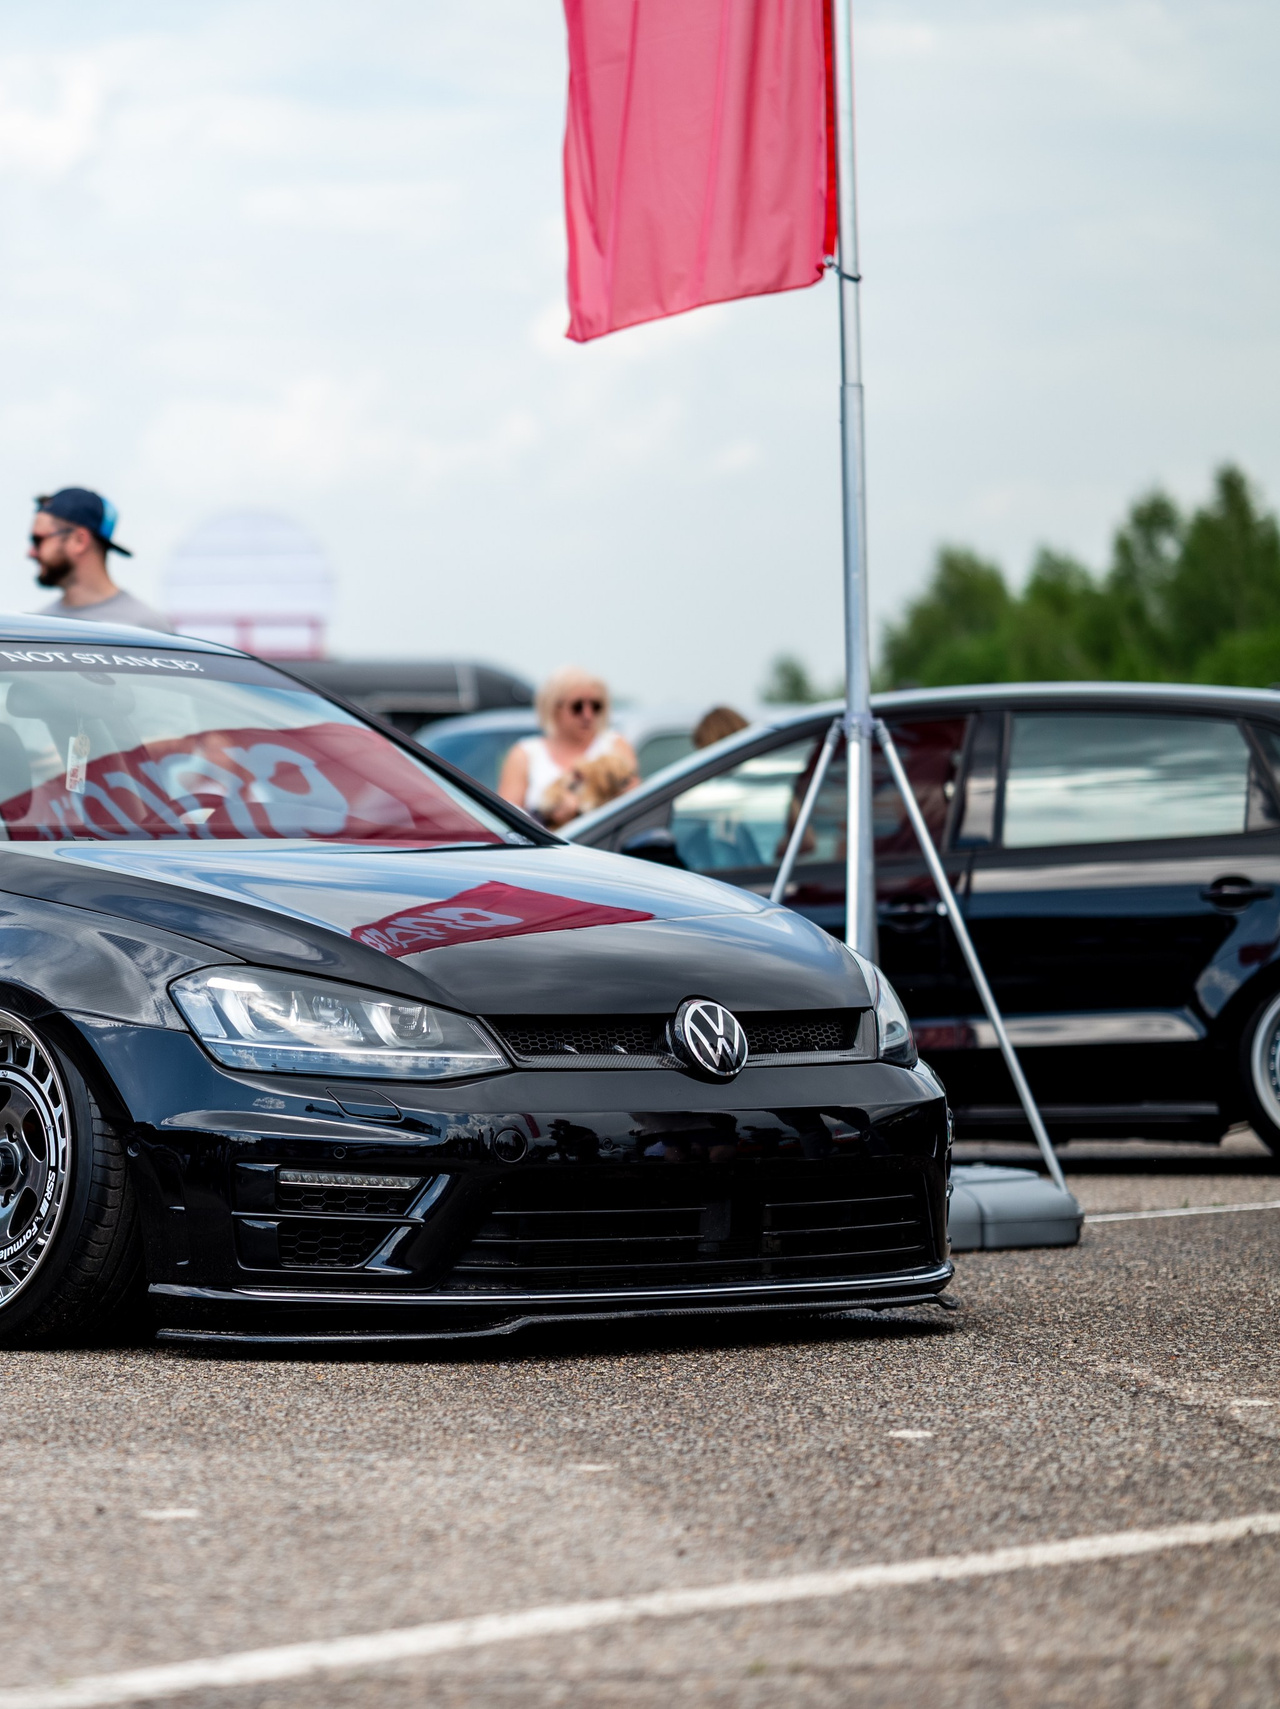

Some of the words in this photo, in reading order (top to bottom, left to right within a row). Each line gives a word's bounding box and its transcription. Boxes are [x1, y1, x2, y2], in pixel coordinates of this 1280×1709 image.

[0, 651, 72, 664] NOT
[71, 652, 205, 672] STANCE?
[43, 1170, 57, 1201] SSR
